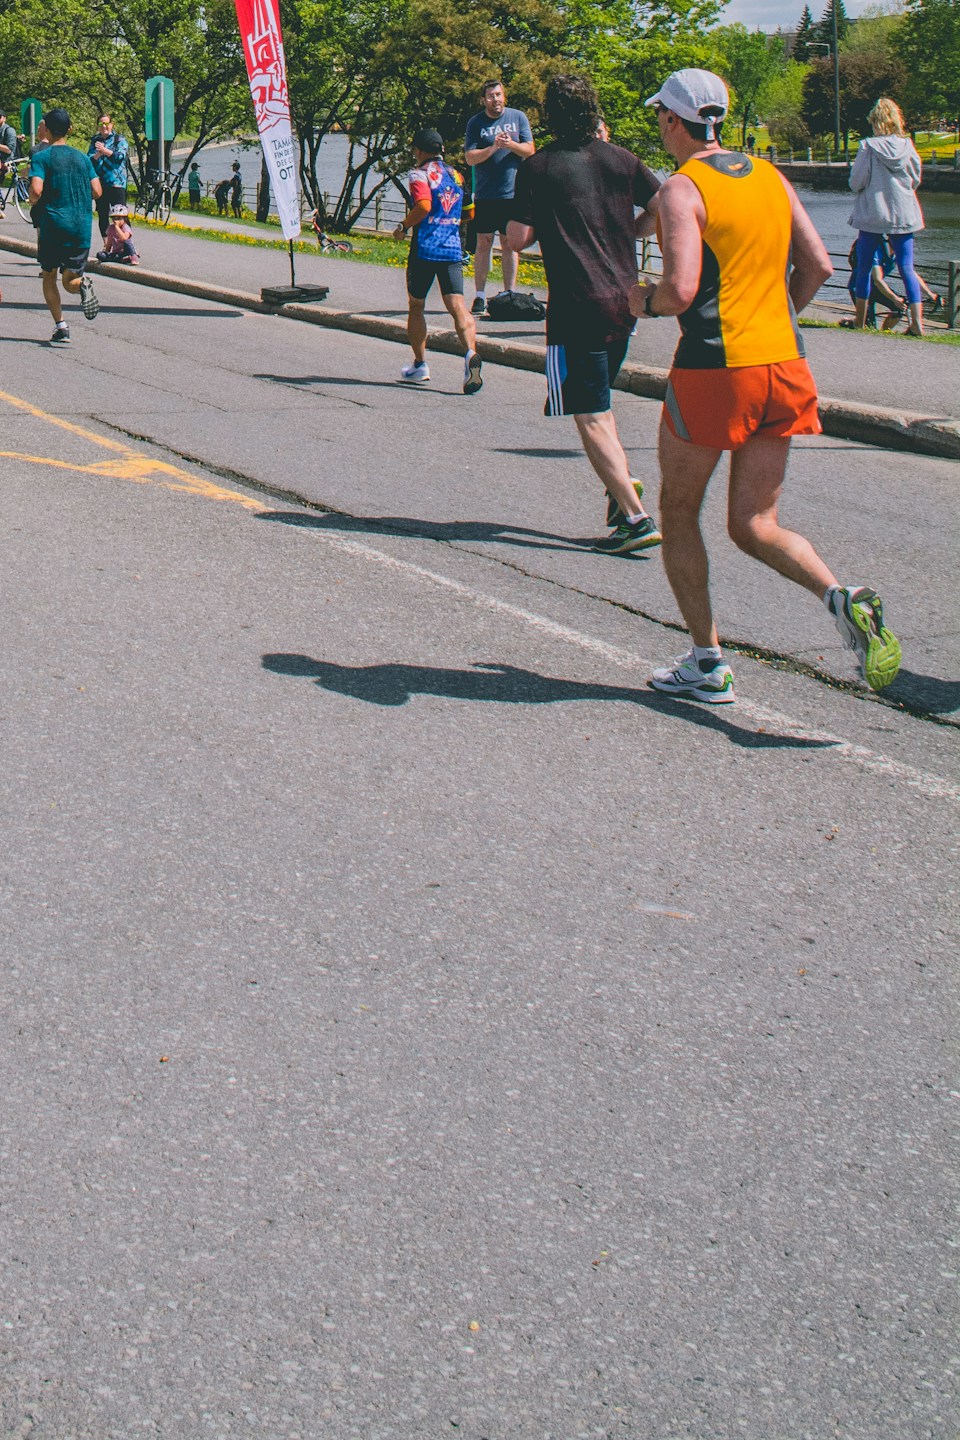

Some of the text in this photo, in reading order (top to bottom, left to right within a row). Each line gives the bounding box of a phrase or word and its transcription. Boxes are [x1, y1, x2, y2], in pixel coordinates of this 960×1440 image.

[480, 122, 517, 138] ATARI
[274, 150, 284, 159] FIN
[276, 158, 287, 167] DES
